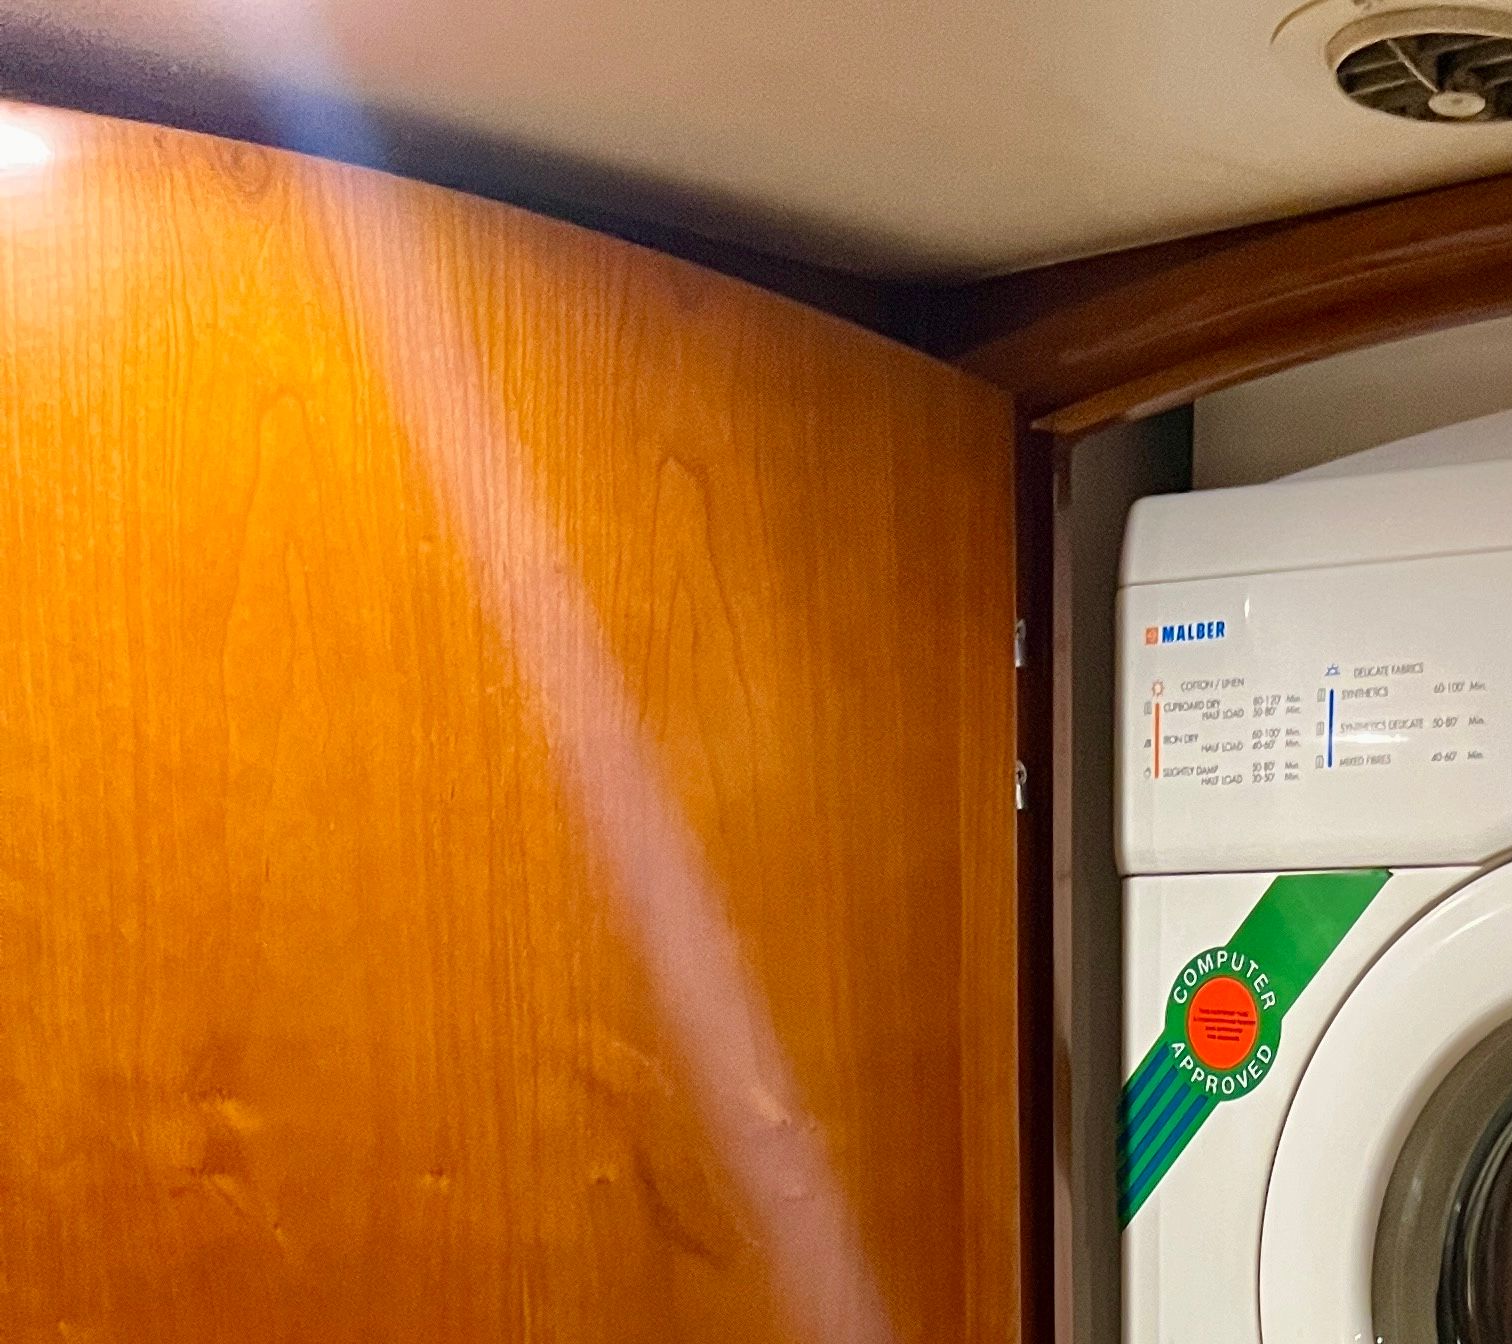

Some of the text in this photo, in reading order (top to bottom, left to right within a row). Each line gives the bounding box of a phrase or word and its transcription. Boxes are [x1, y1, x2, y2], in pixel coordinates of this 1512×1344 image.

[1162, 621, 1226, 643] MALBER
[1354, 662, 1424, 678] DELICATE FABRICS
[1181, 680, 1214, 692] COTTON
[1341, 687, 1389, 700] SYNTHETICS
[1163, 702, 1204, 713] CUPBOARD
[1206, 700, 1220, 709] DRY
[1202, 710, 1220, 720] HALF
[1222, 709, 1244, 719] LOAD
[1163, 735, 1182, 745] IRON
[1184, 734, 1199, 744] DRY
[1201, 743, 1219, 752] HALF
[1221, 741, 1243, 751] LOAD
[1201, 776, 1219, 785] HALF
[1221, 774, 1243, 785] LOAD
[1173, 950, 1276, 1010] COMPUTER
[1171, 1042, 1273, 1095] APPROVED
